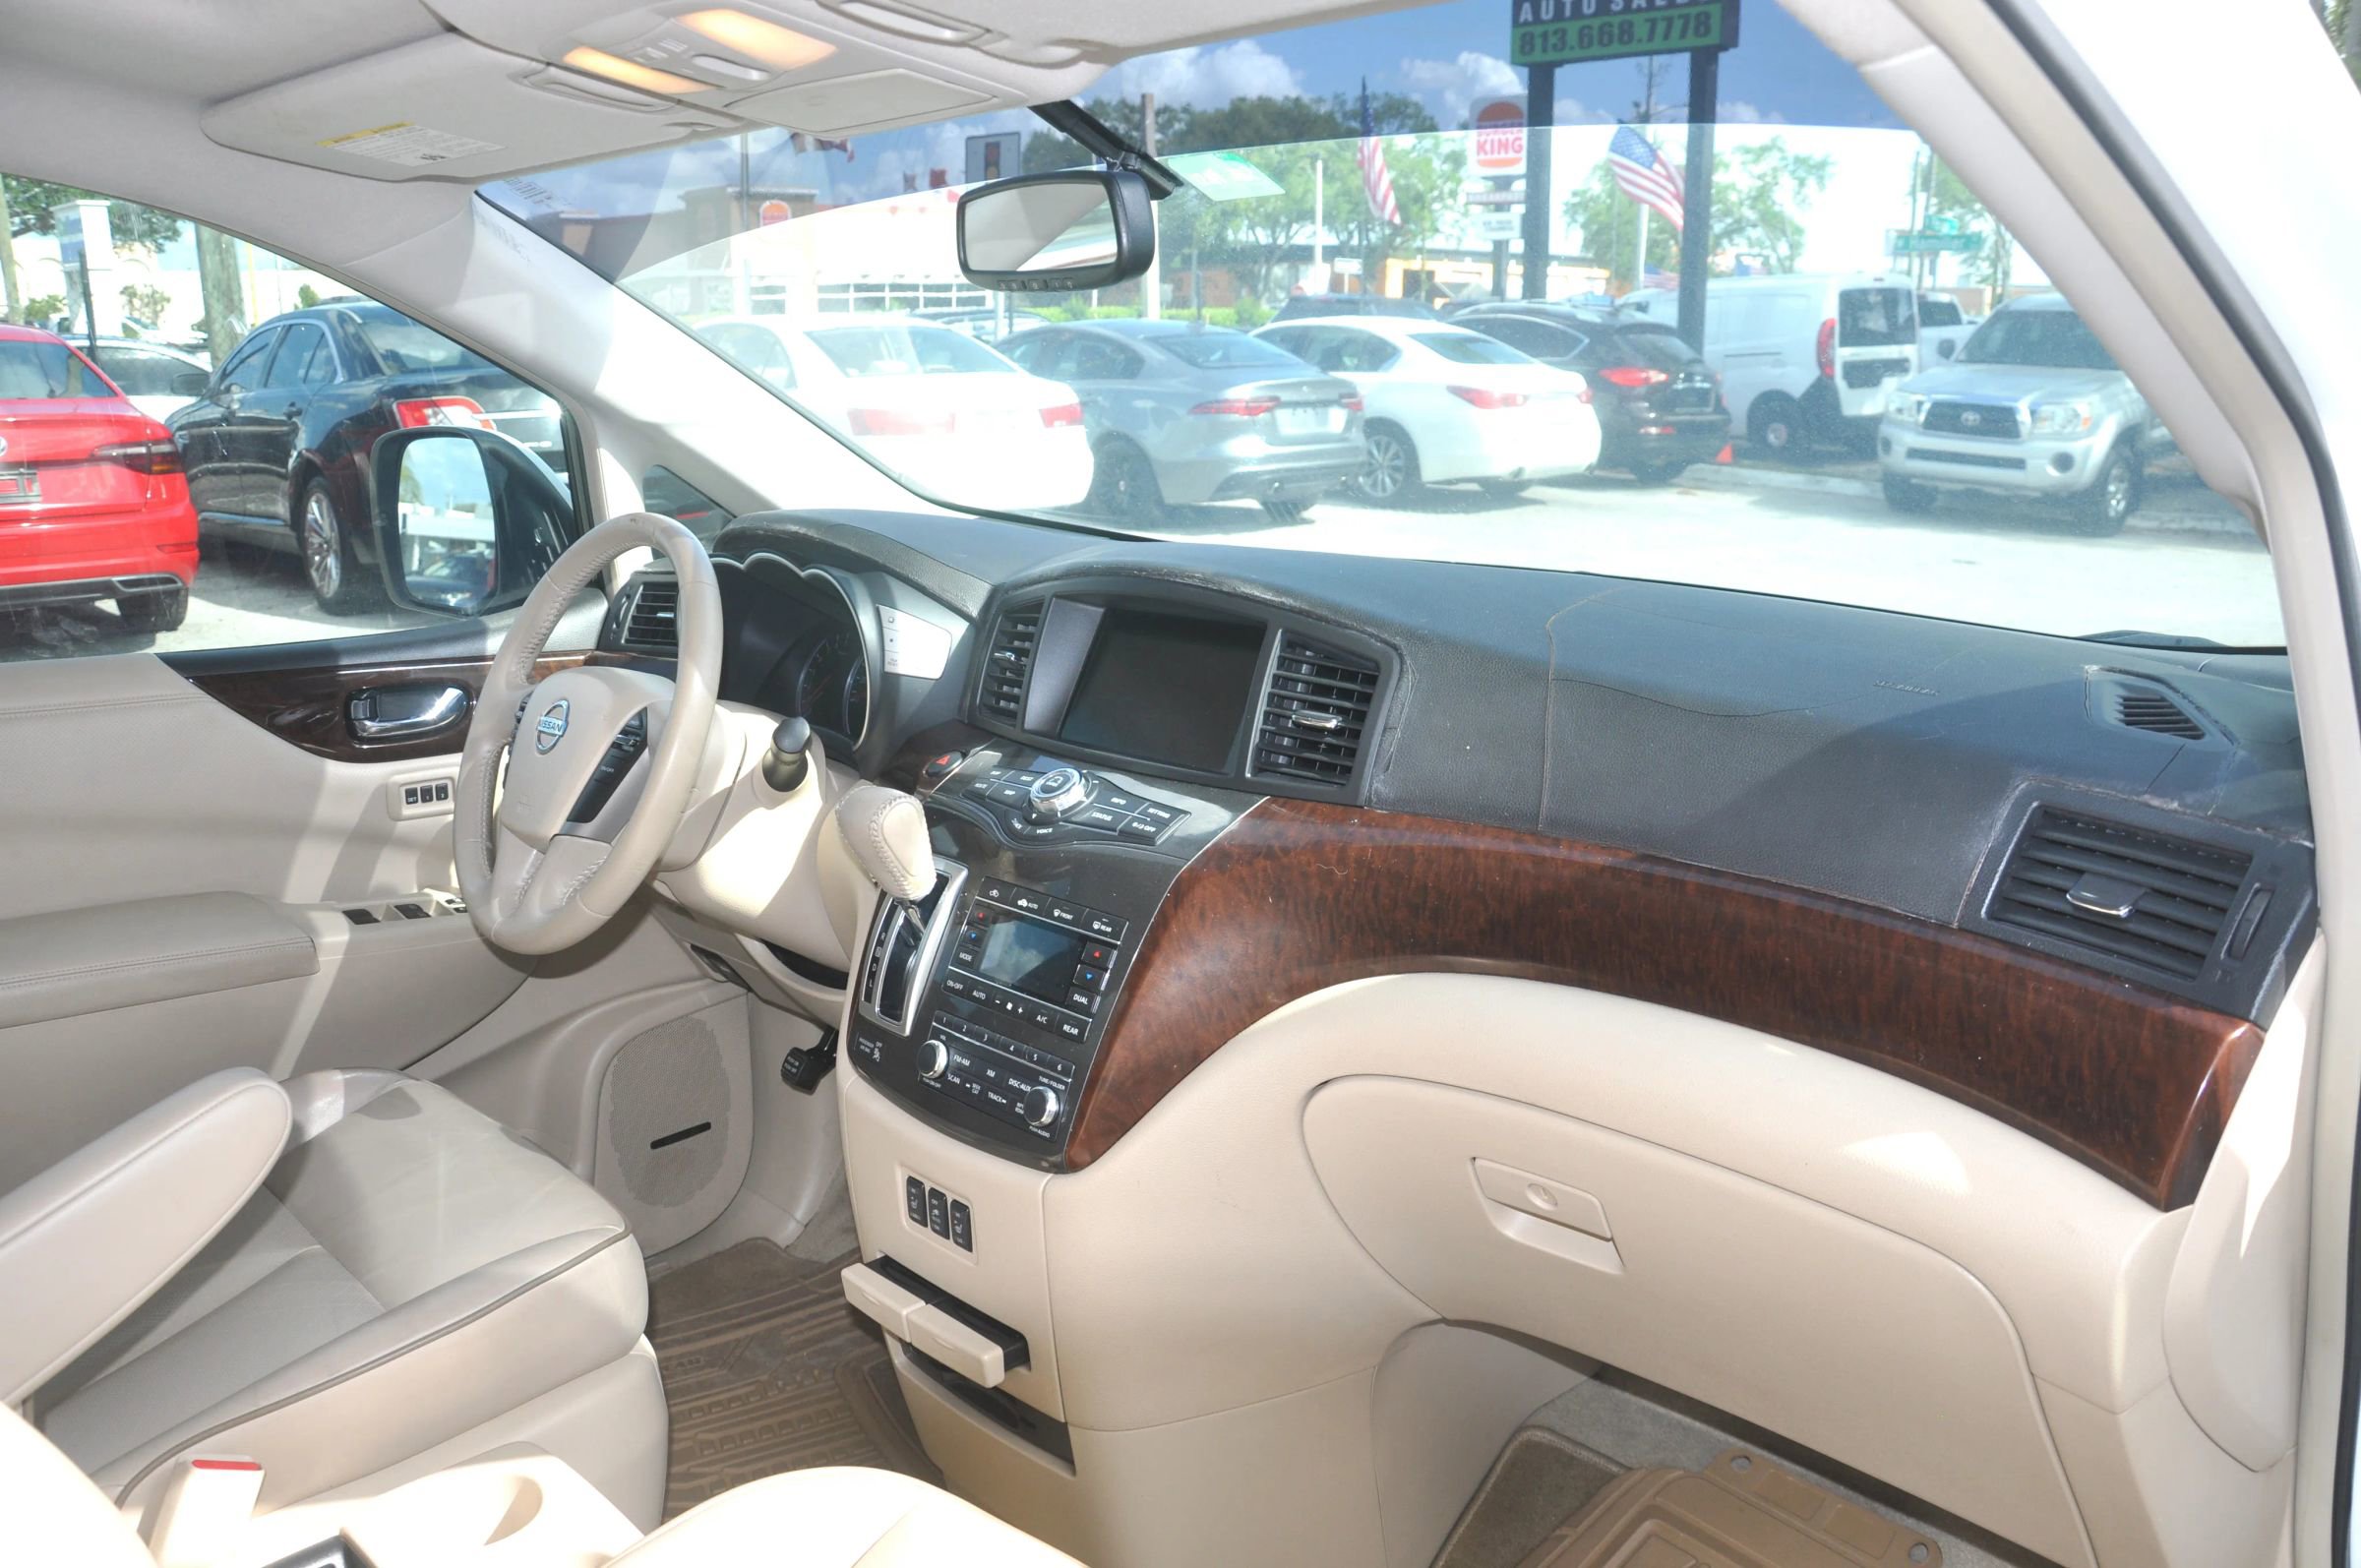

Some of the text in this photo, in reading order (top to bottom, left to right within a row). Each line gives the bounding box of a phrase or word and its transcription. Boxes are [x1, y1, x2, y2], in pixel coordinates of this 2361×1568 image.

[1519, 0, 1596, 24] AUTO
[1519, 11, 1713, 56] 813.668.7778
[1477, 136, 1524, 156] KING
[1059, 912, 1074, 921] FRONT
[1100, 924, 1113, 933] REAR
[959, 952, 973, 962] MODE
[972, 991, 986, 1000] AUTO
[1072, 994, 1089, 1005] DUAL
[1036, 1014, 1049, 1024] A/C
[1062, 1024, 1079, 1036] REAR
[986, 1068, 997, 1078] XM
[947, 1073, 961, 1085] SCAN
[988, 1091, 1002, 1103] TRACK
